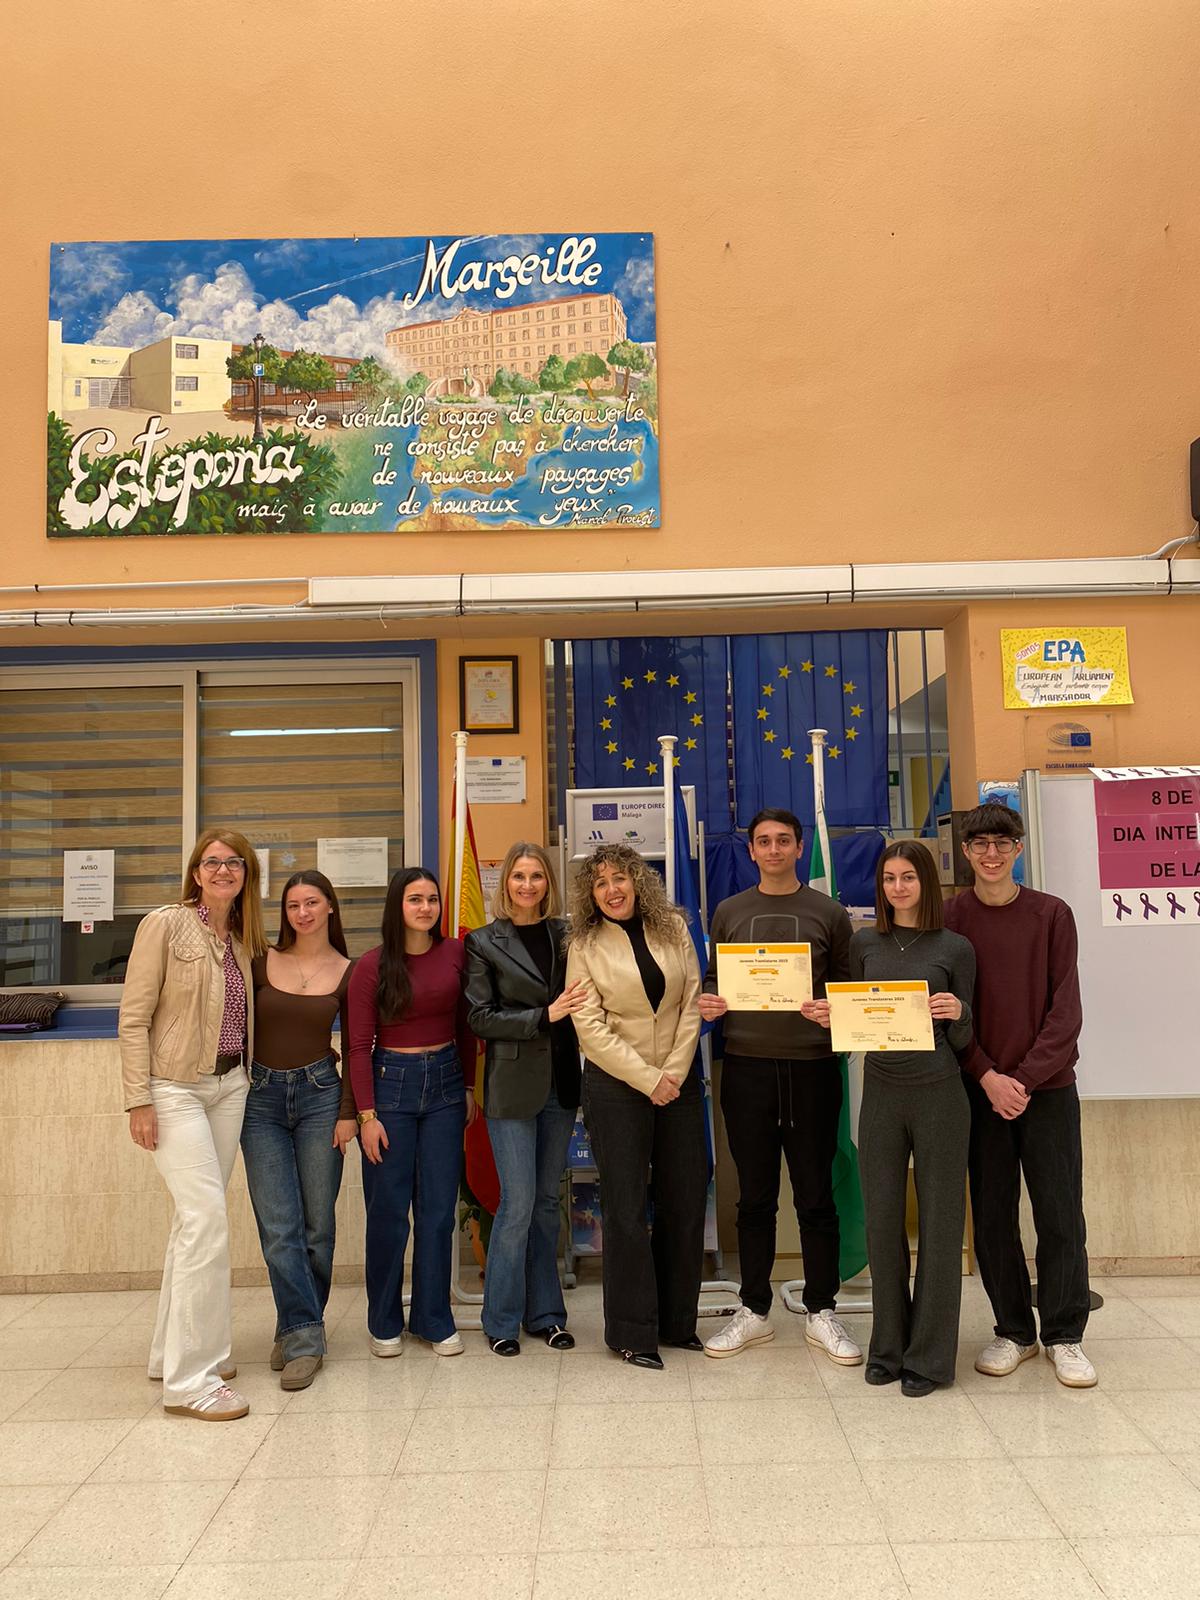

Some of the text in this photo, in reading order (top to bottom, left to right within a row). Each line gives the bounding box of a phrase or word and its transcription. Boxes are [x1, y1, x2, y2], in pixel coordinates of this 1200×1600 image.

[404, 237, 603, 310] Marseille
[341, 394, 430, 428] véritable
[438, 410, 498, 440] voyage
[508, 393, 535, 424] de
[543, 392, 644, 424] découverte
[373, 424, 640, 464] ne consiste pas à chercher
[58, 415, 303, 532] Estepona
[372, 457, 632, 494] de nouveaux paysages
[236, 498, 289, 524] mais
[302, 497, 316, 516] à
[328, 497, 384, 516] avoir
[397, 486, 422, 515] de
[431, 499, 520, 514] nouveaux
[564, 504, 657, 527] Marcel Proust
[1015, 639, 1086, 663] SOMOS EPA
[1016, 665, 1063, 682] EUROPEAN
[1152, 789, 1194, 806] 8 DE
[1113, 827, 1145, 842] DIA
[1150, 862, 1177, 878] DE
[577, 1150, 589, 1158] UE
